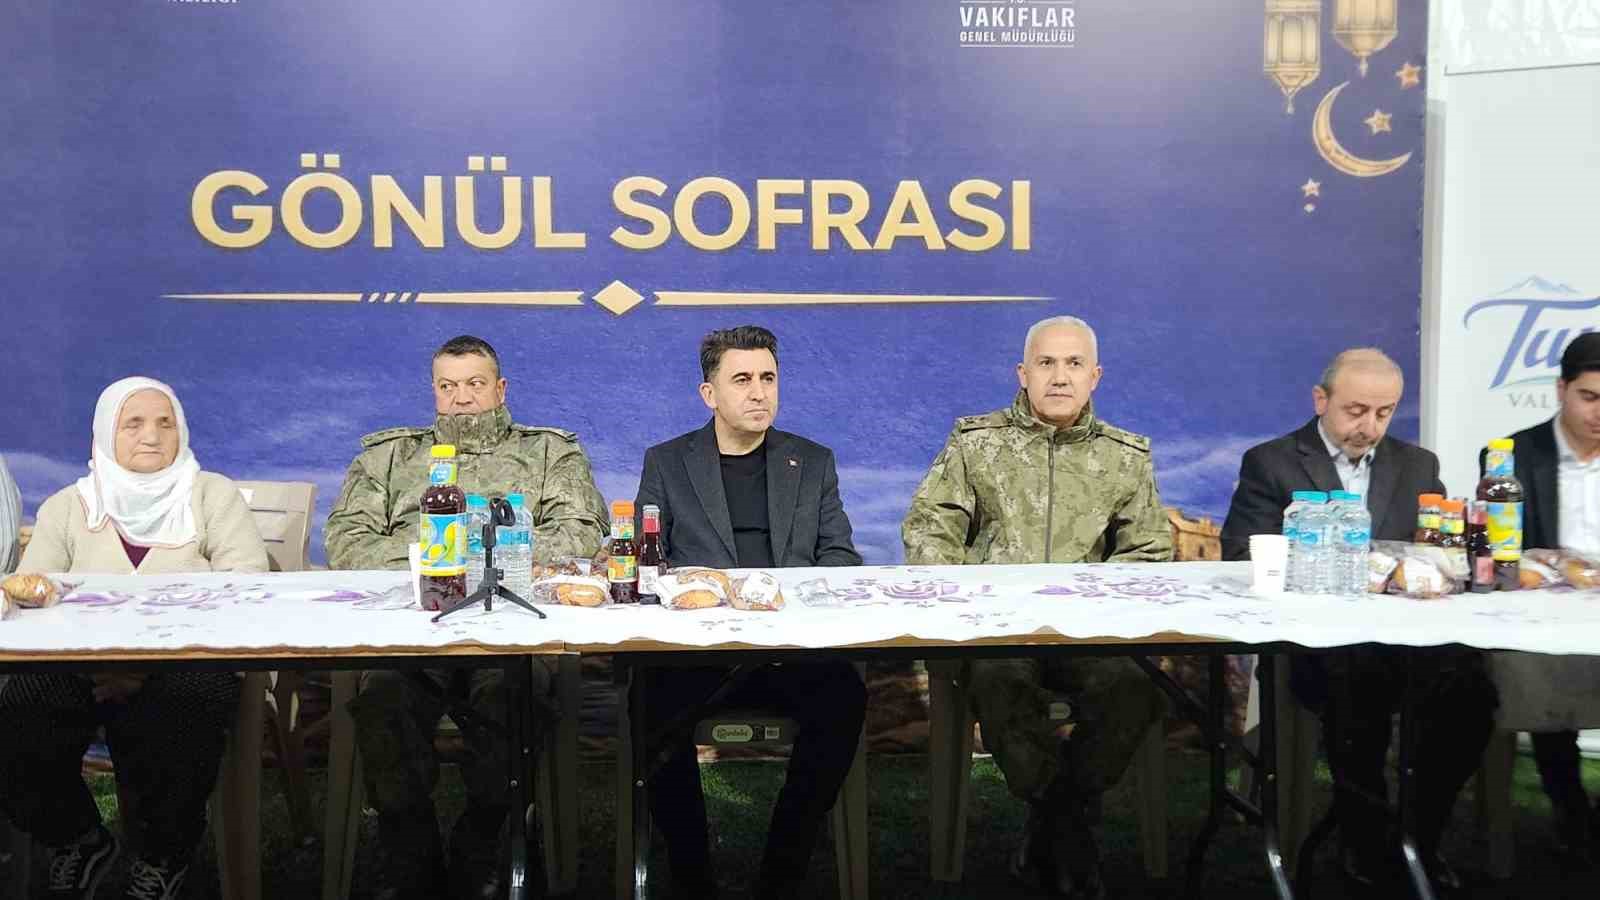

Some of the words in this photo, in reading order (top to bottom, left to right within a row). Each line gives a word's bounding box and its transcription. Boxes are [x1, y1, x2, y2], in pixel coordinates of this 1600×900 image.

[960, 6, 1076, 28] VAKIFLAR
[960, 31, 997, 43] GENEL
[1001, 28, 1075, 43] MÜDÜRLÜĞÜ
[191, 153, 587, 250] GÖNÜL
[610, 177, 1034, 252] SOFRASI
